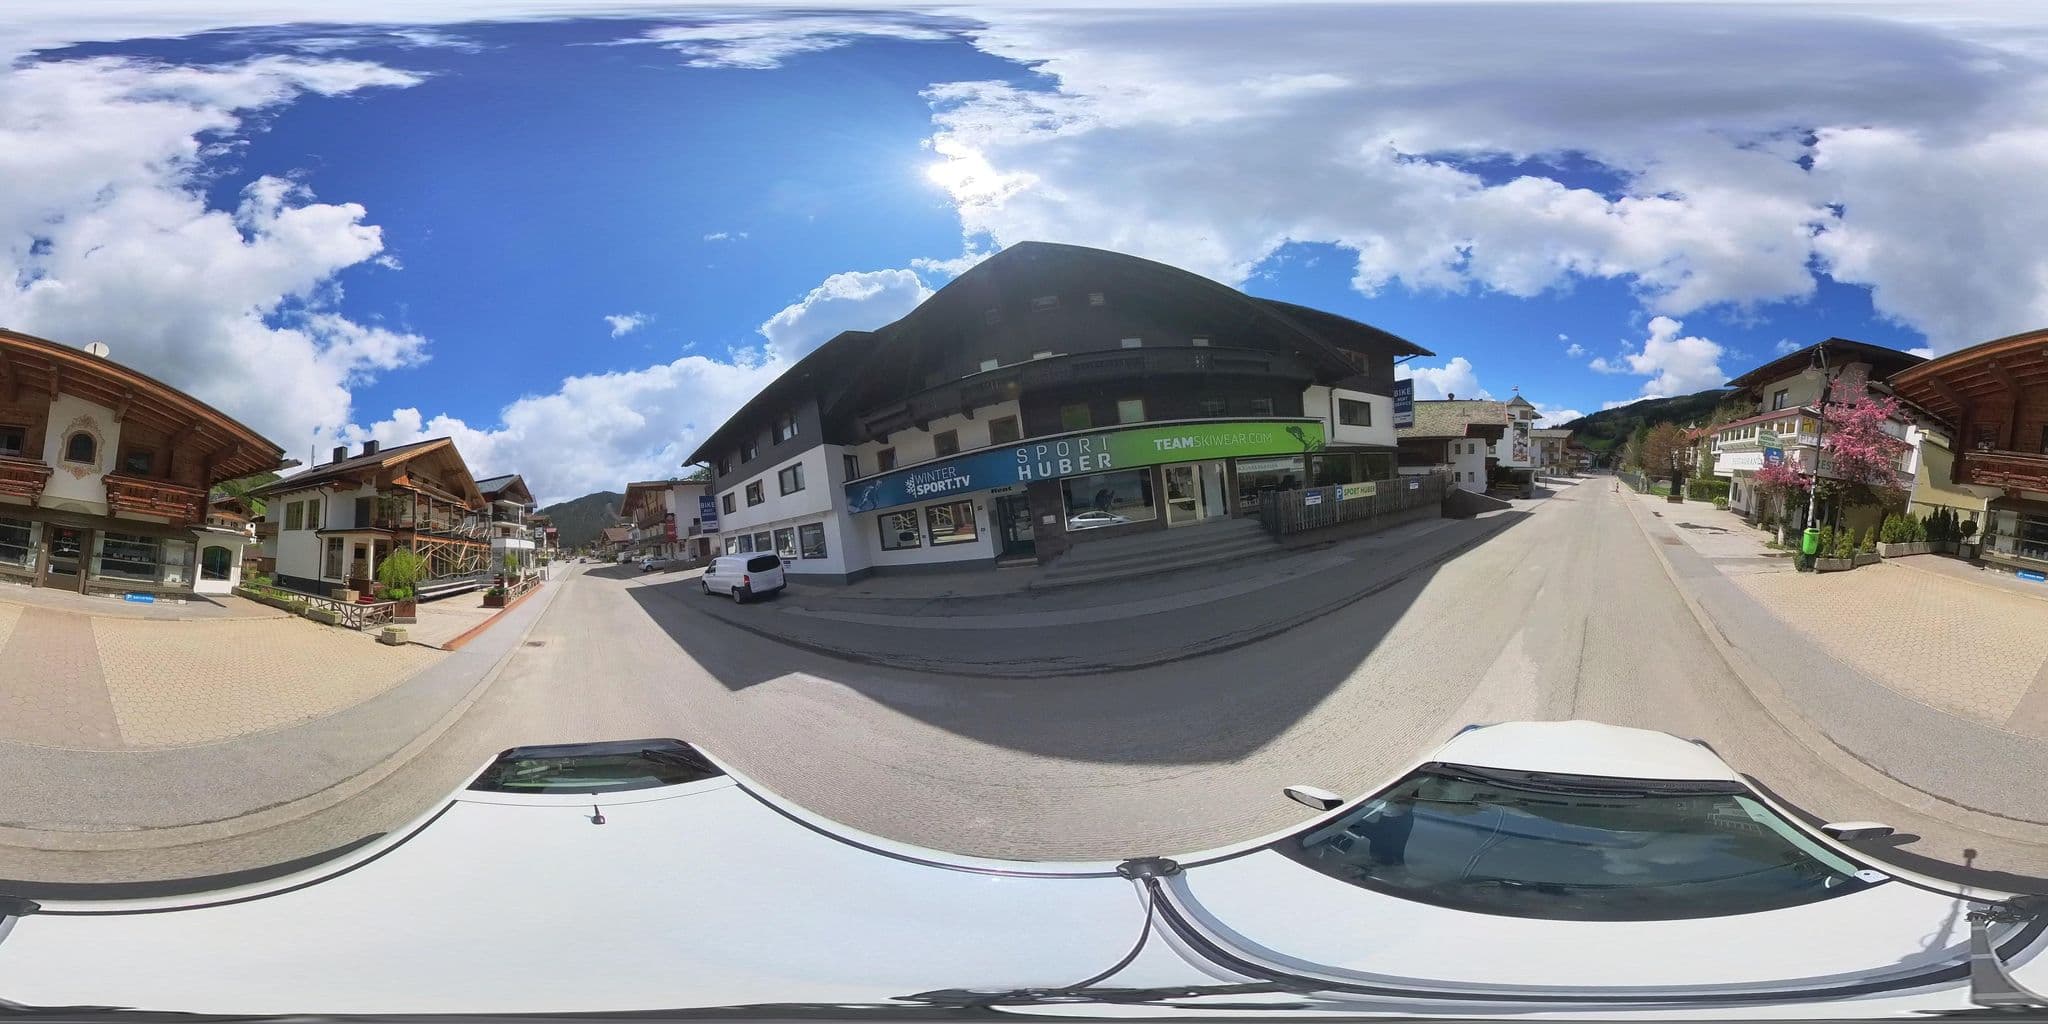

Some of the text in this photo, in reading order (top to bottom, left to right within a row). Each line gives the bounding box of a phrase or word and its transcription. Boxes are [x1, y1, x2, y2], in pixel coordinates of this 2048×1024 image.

[1393, 387, 1411, 397] BIKE
[1153, 432, 1272, 450] TEAMSKIWEAR.COM
[914, 466, 957, 485] WINTER
[1018, 452, 1112, 481] HUBER
[916, 474, 970, 496] SPORT.TV
[1344, 487, 1359, 496] SPORT
